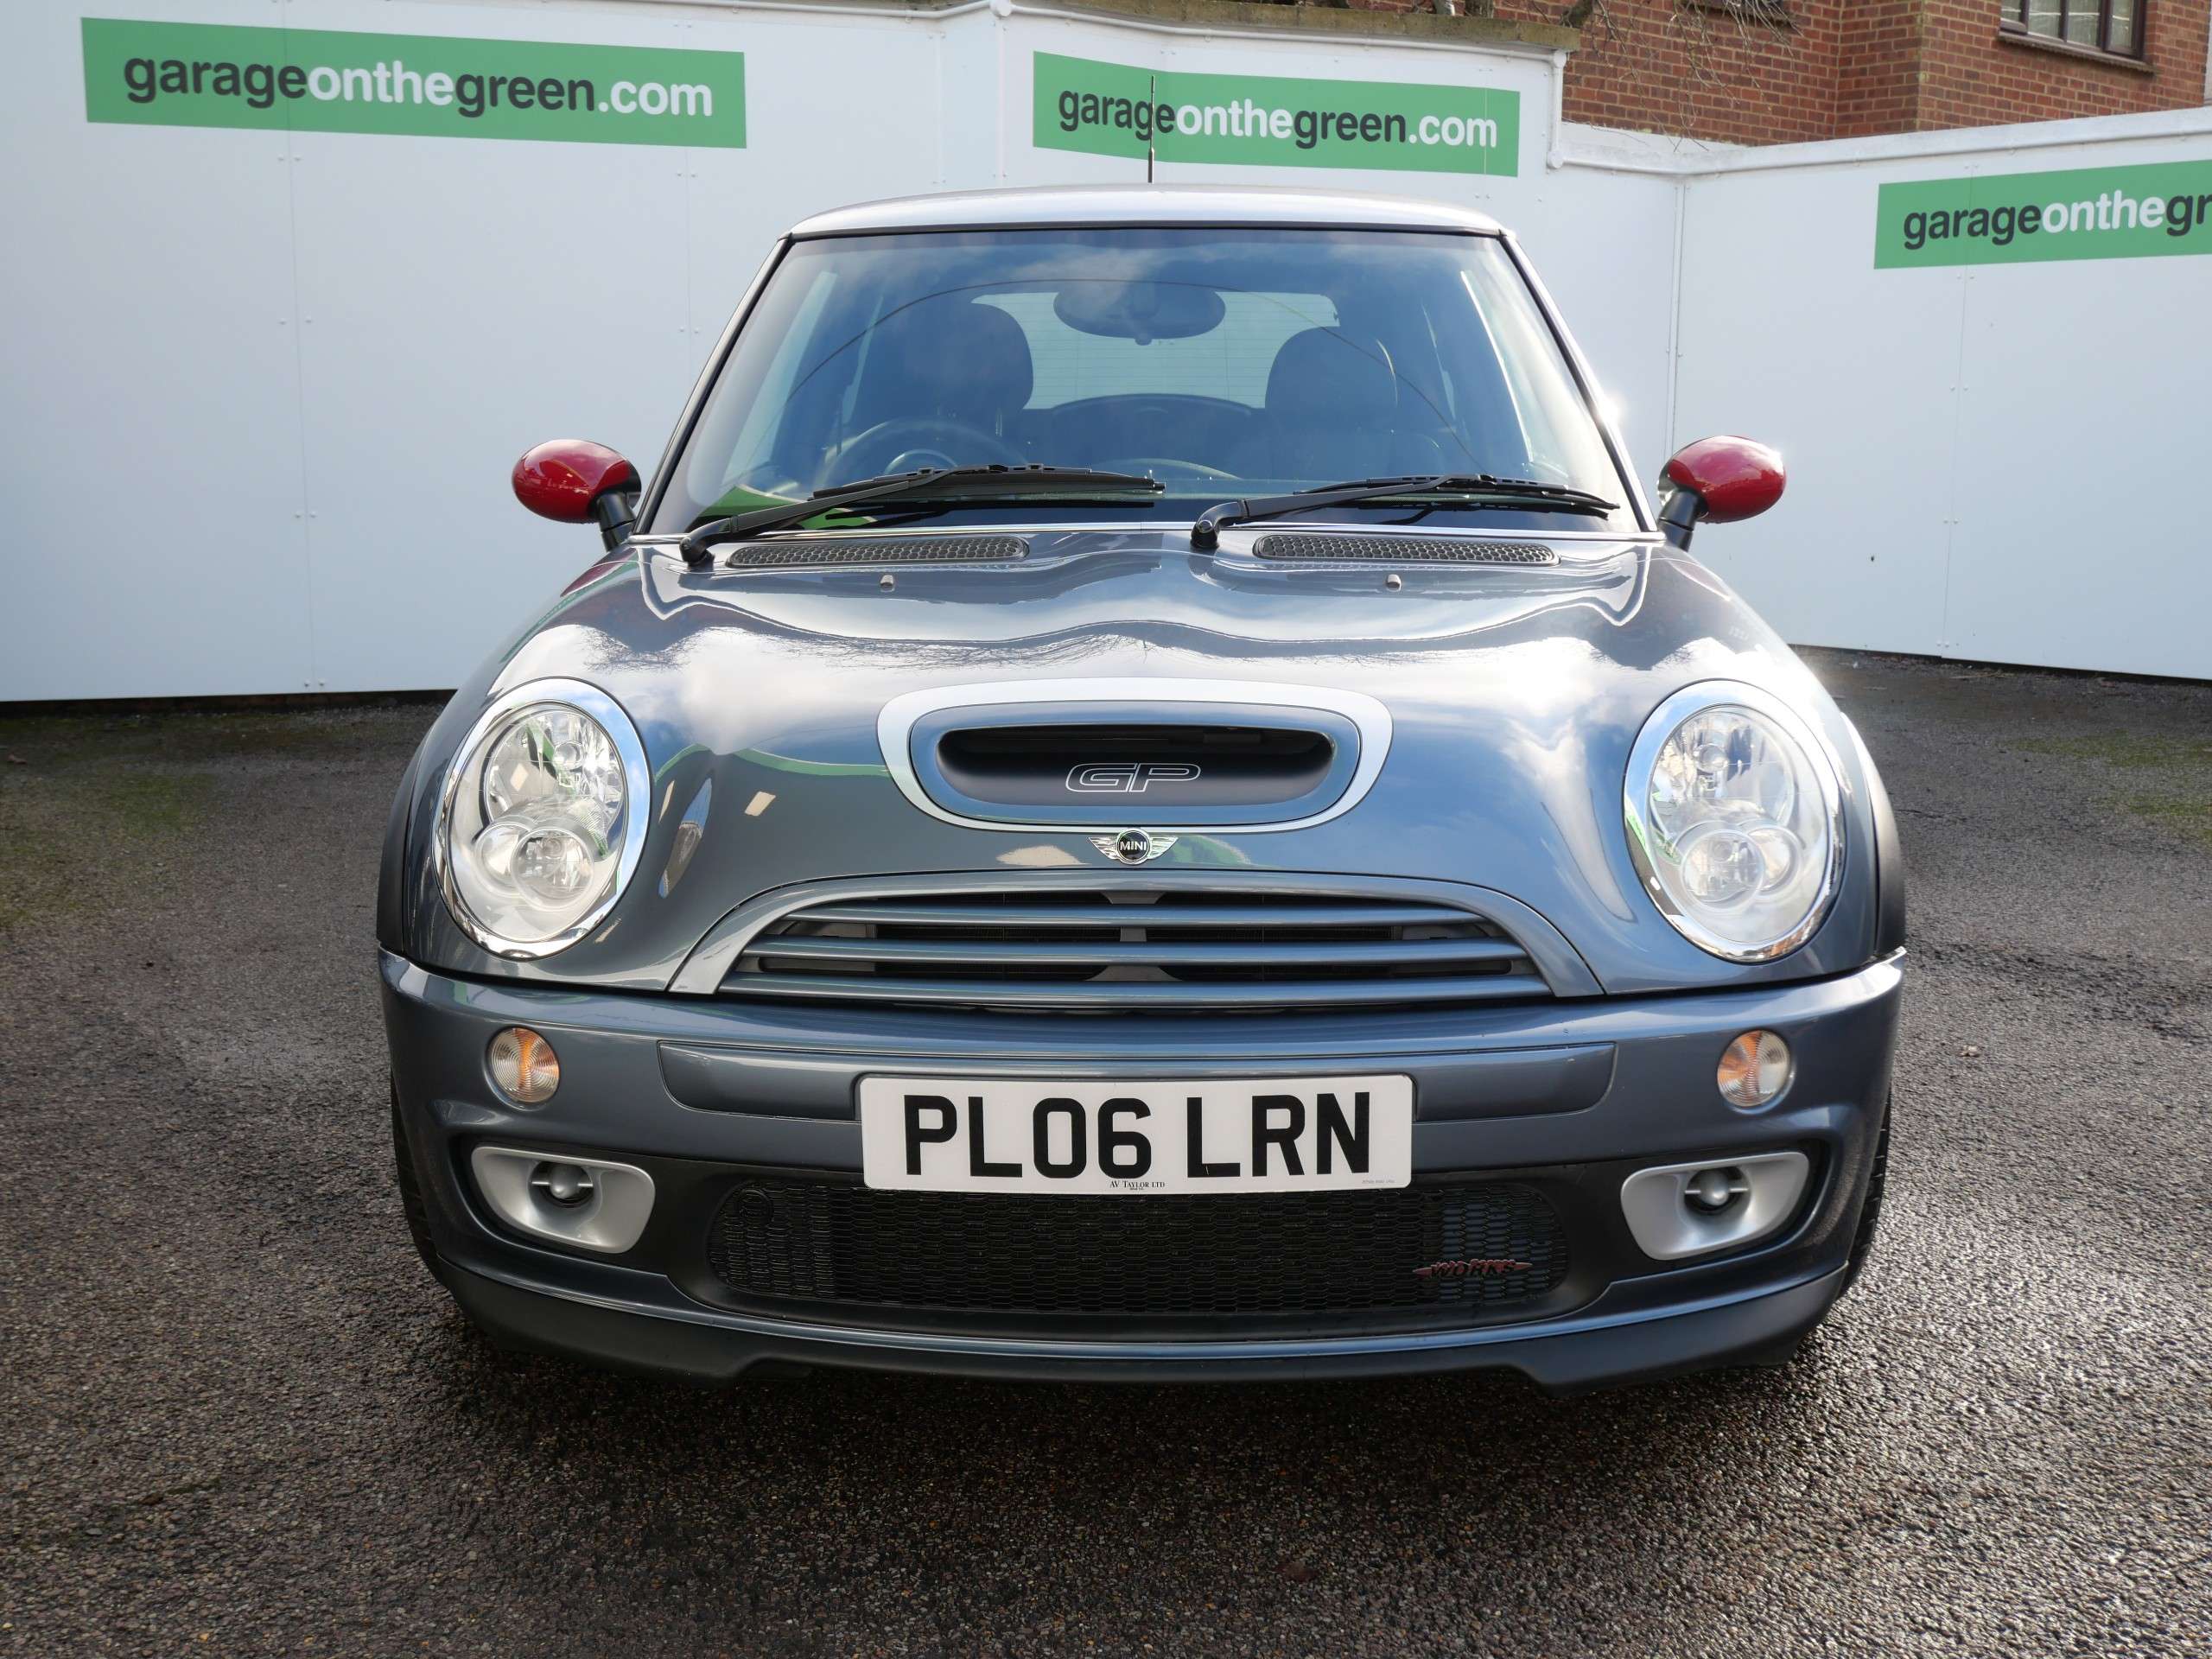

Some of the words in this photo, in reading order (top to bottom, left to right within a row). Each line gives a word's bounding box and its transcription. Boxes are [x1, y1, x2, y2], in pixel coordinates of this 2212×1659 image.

[124, 57, 714, 118] garageonthegreen.com
[1058, 89, 1497, 149] garageonthegreen.com
[1065, 762, 1201, 792] GP
[1120, 841, 1147, 851] MINI
[904, 1095, 1152, 1179] PL06
[1186, 1091, 1370, 1178] LRN
